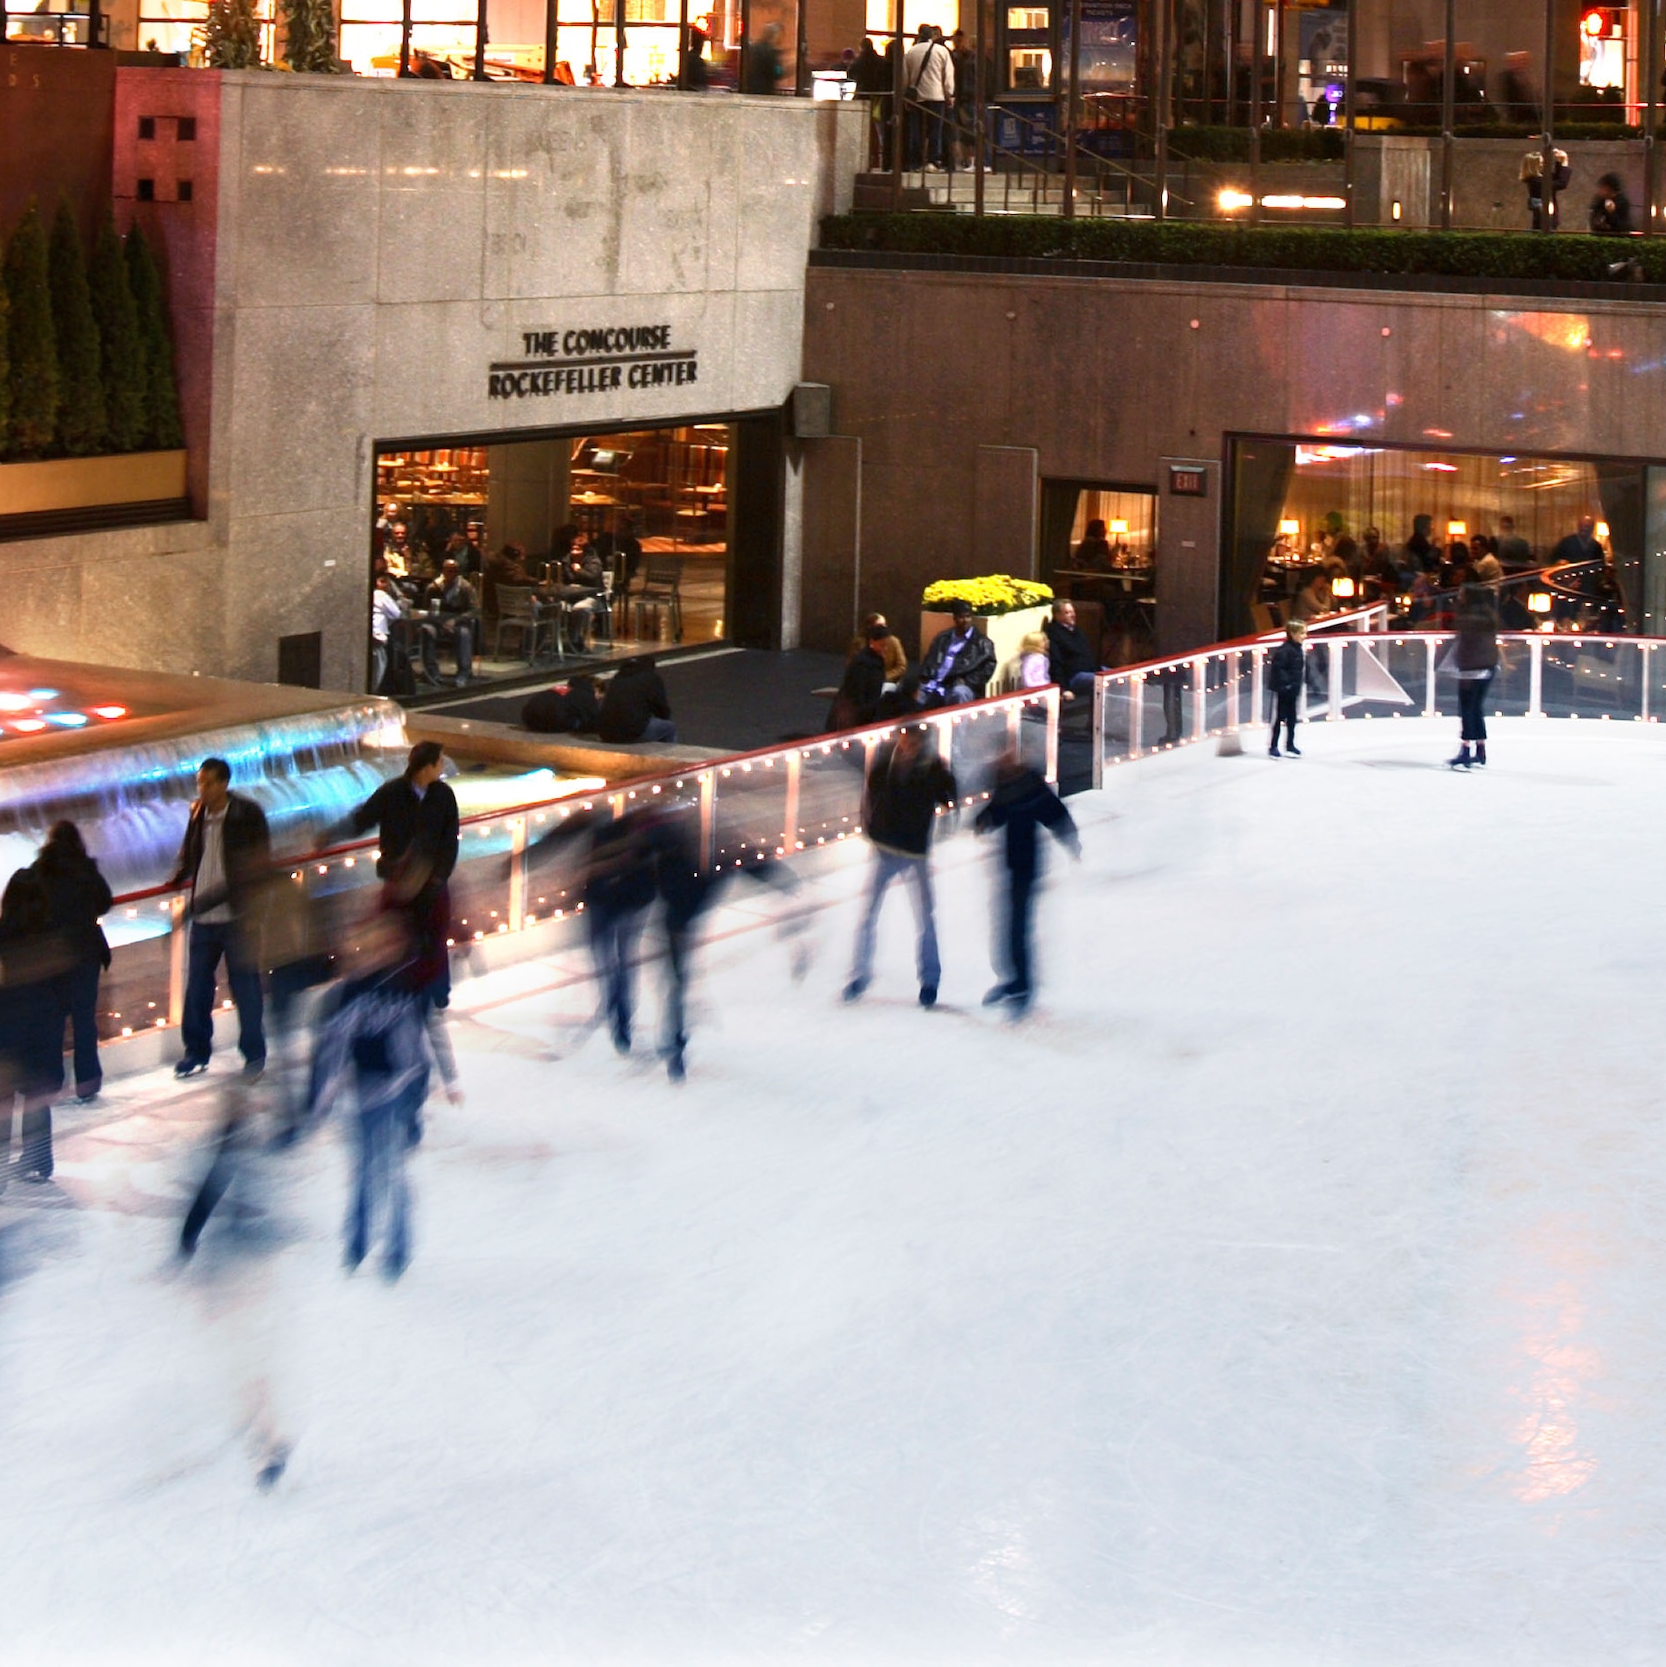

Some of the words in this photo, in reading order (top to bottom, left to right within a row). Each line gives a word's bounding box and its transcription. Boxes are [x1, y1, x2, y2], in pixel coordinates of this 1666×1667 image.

[523, 331, 559, 357] THE
[563, 324, 671, 356] CONCOURSE
[488, 365, 622, 400] ROCKEFELLER
[628, 360, 698, 390] CENTER
